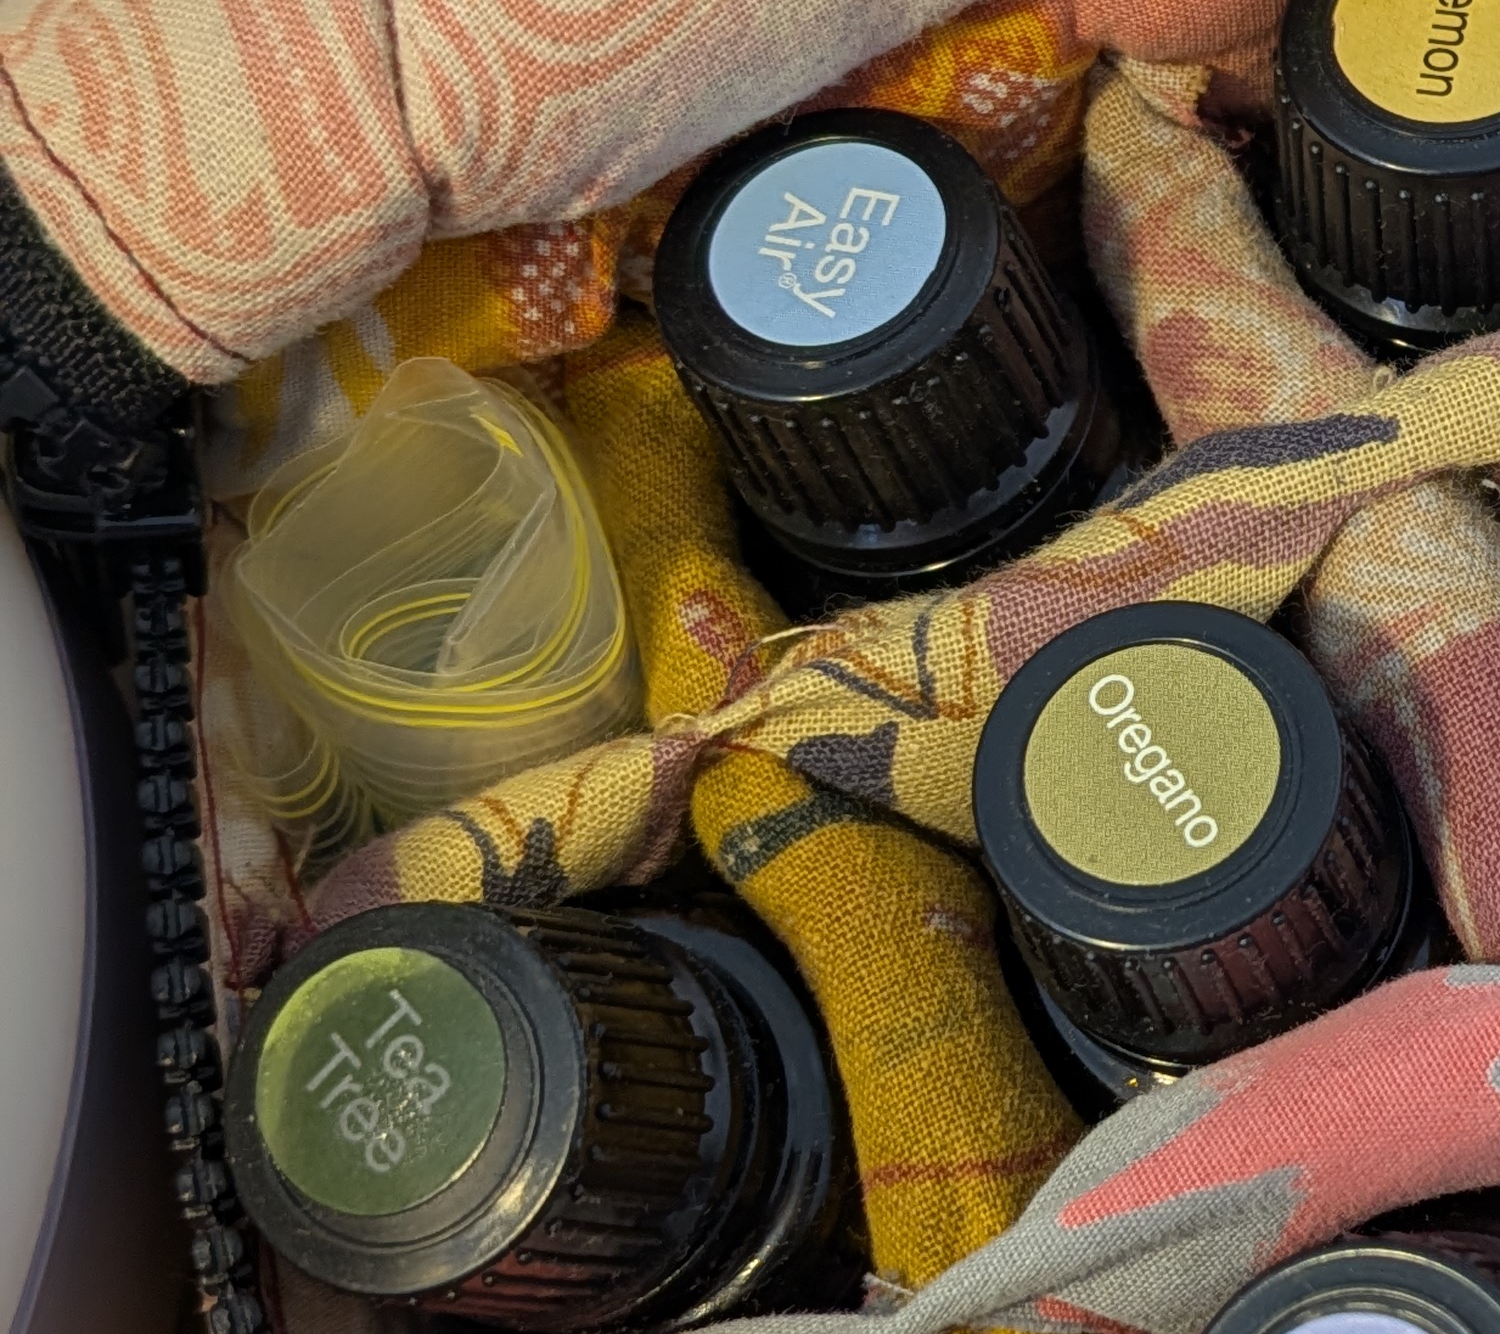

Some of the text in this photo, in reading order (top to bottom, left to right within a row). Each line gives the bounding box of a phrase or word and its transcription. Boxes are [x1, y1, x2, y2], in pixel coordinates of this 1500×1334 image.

[793, 187, 900, 318] Easy
[1088, 674, 1219, 848] Oregano
[305, 1032, 406, 1173] Tree
[365, 989, 450, 1115] Tea
